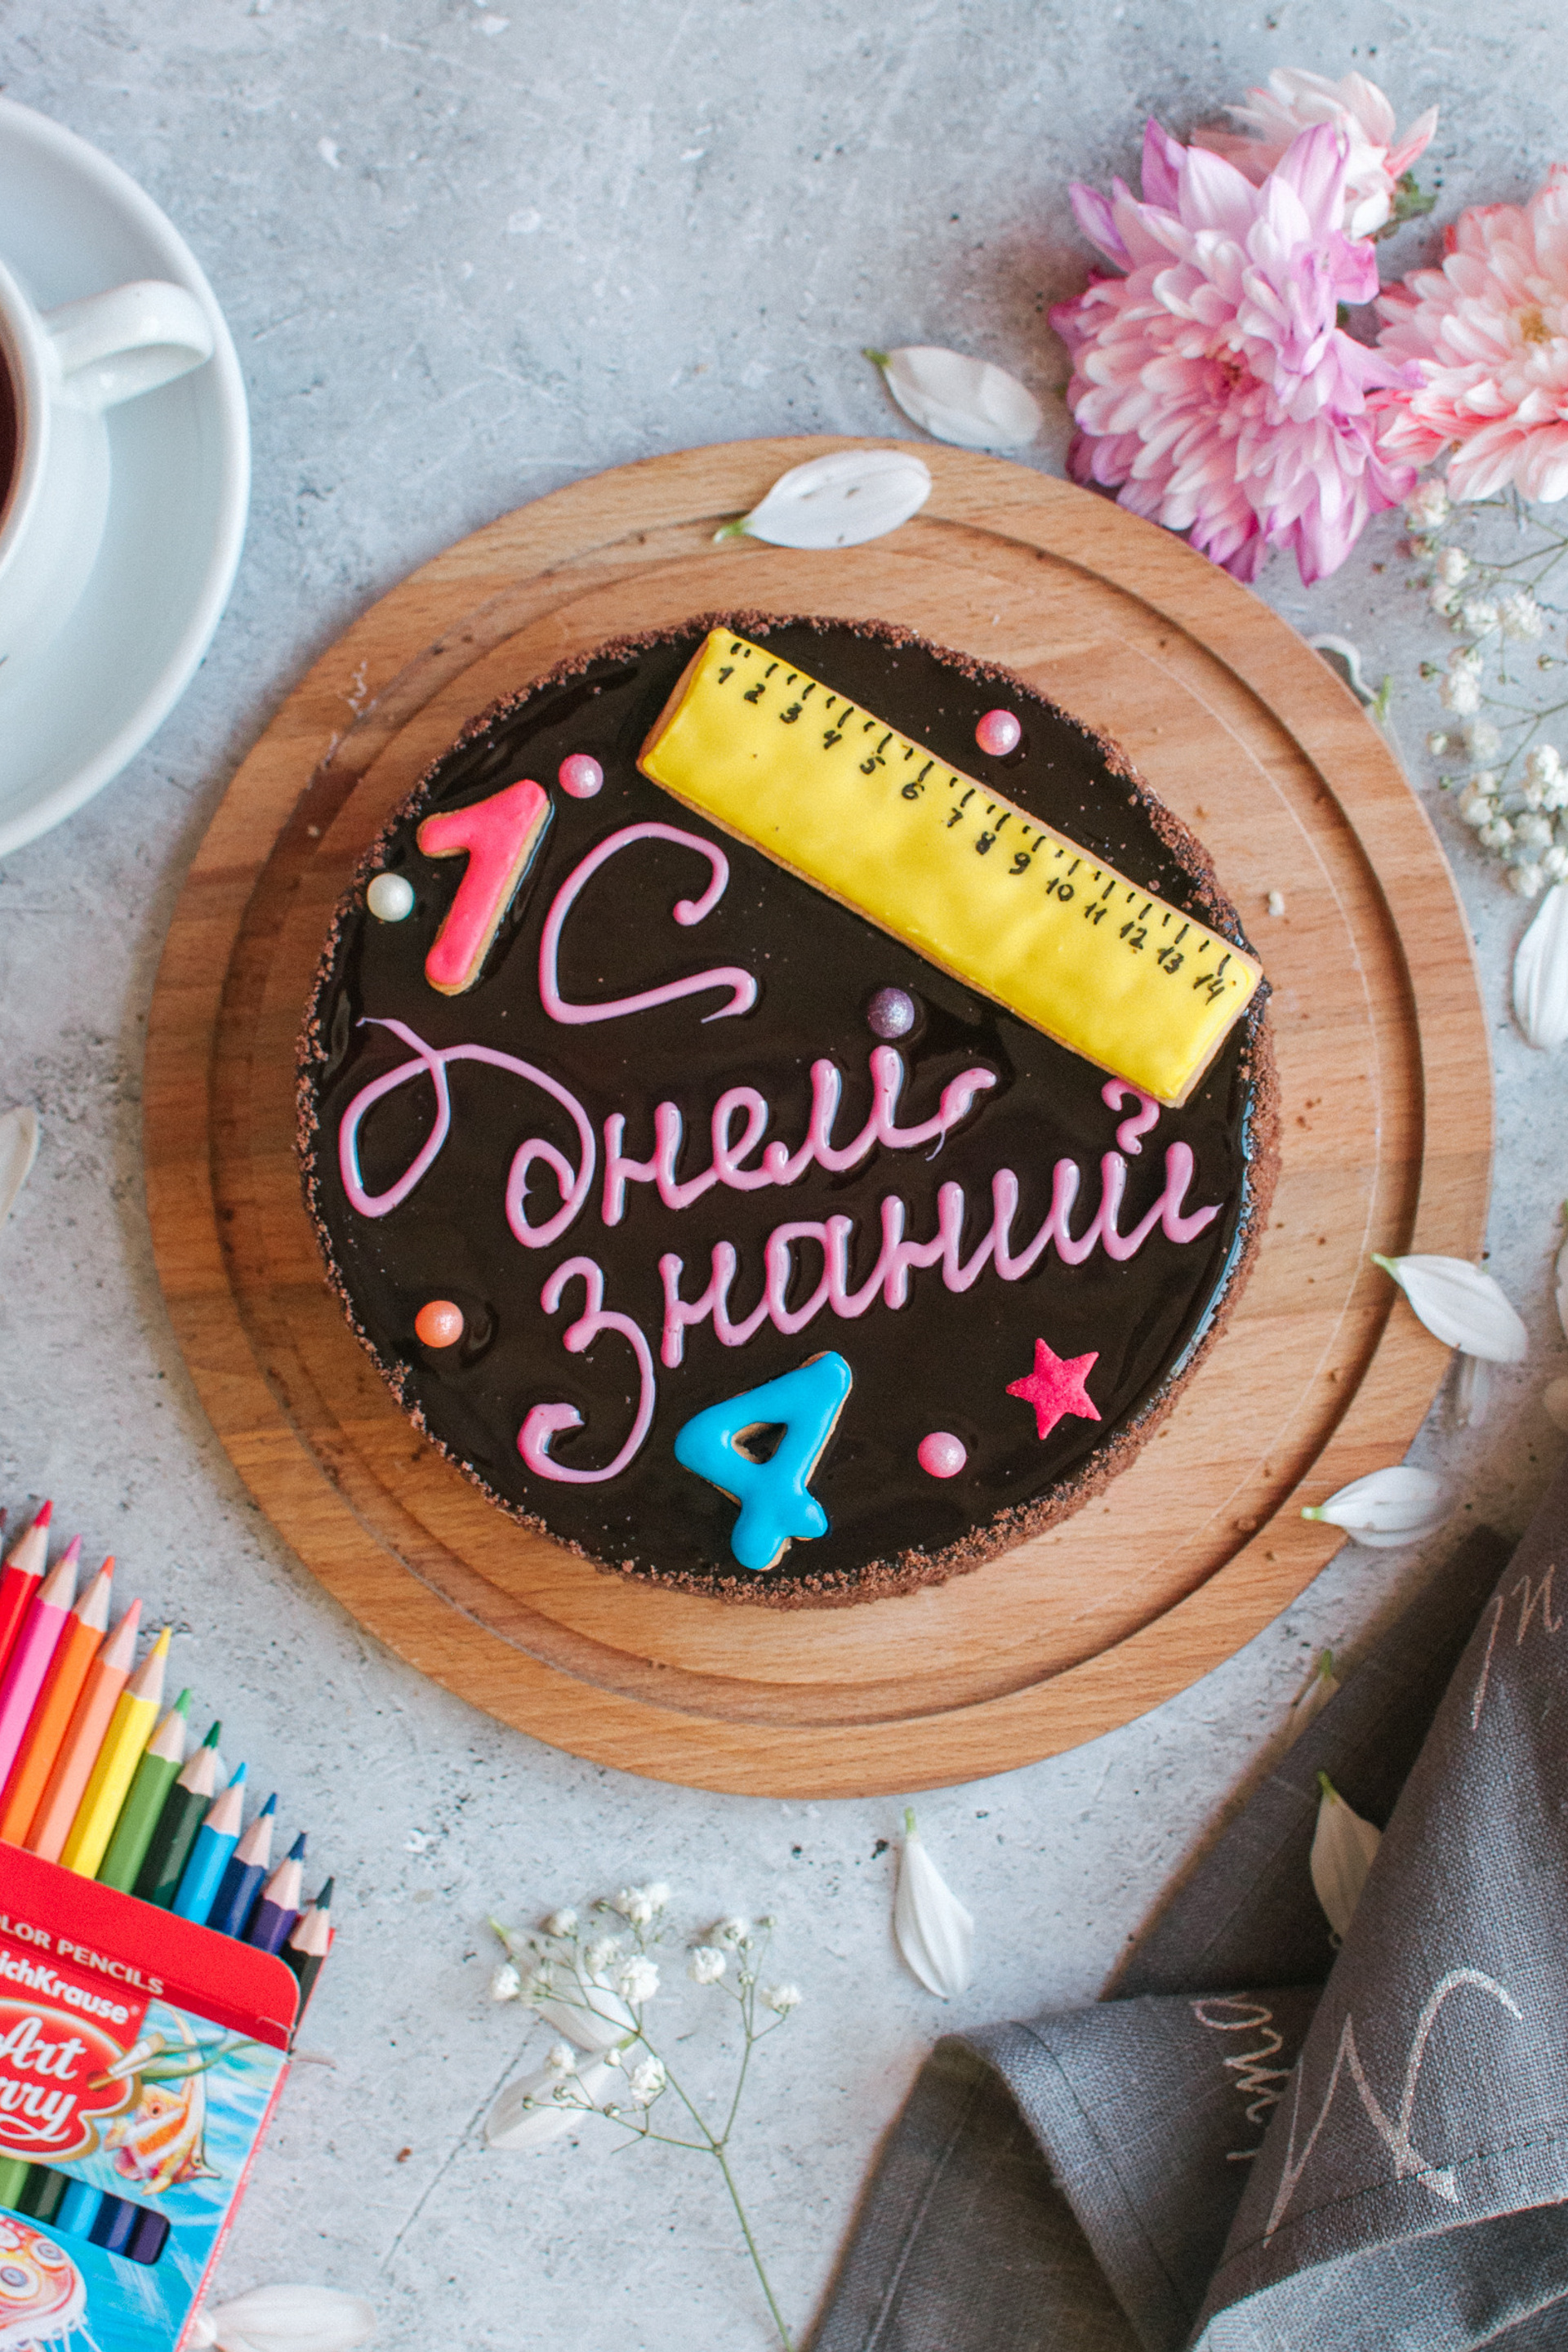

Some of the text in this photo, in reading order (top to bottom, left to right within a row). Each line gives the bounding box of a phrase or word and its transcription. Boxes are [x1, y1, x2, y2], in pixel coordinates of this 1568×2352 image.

[416, 778, 550, 996] 1
[719, 666, 1225, 1005] 1 2 3 4 5 6 7 8 9 10 11 12 13 14
[674, 1350, 853, 1570] 4
[0, 1913, 165, 1995] LOR PENCILS
[0, 2017, 87, 2081] Art
